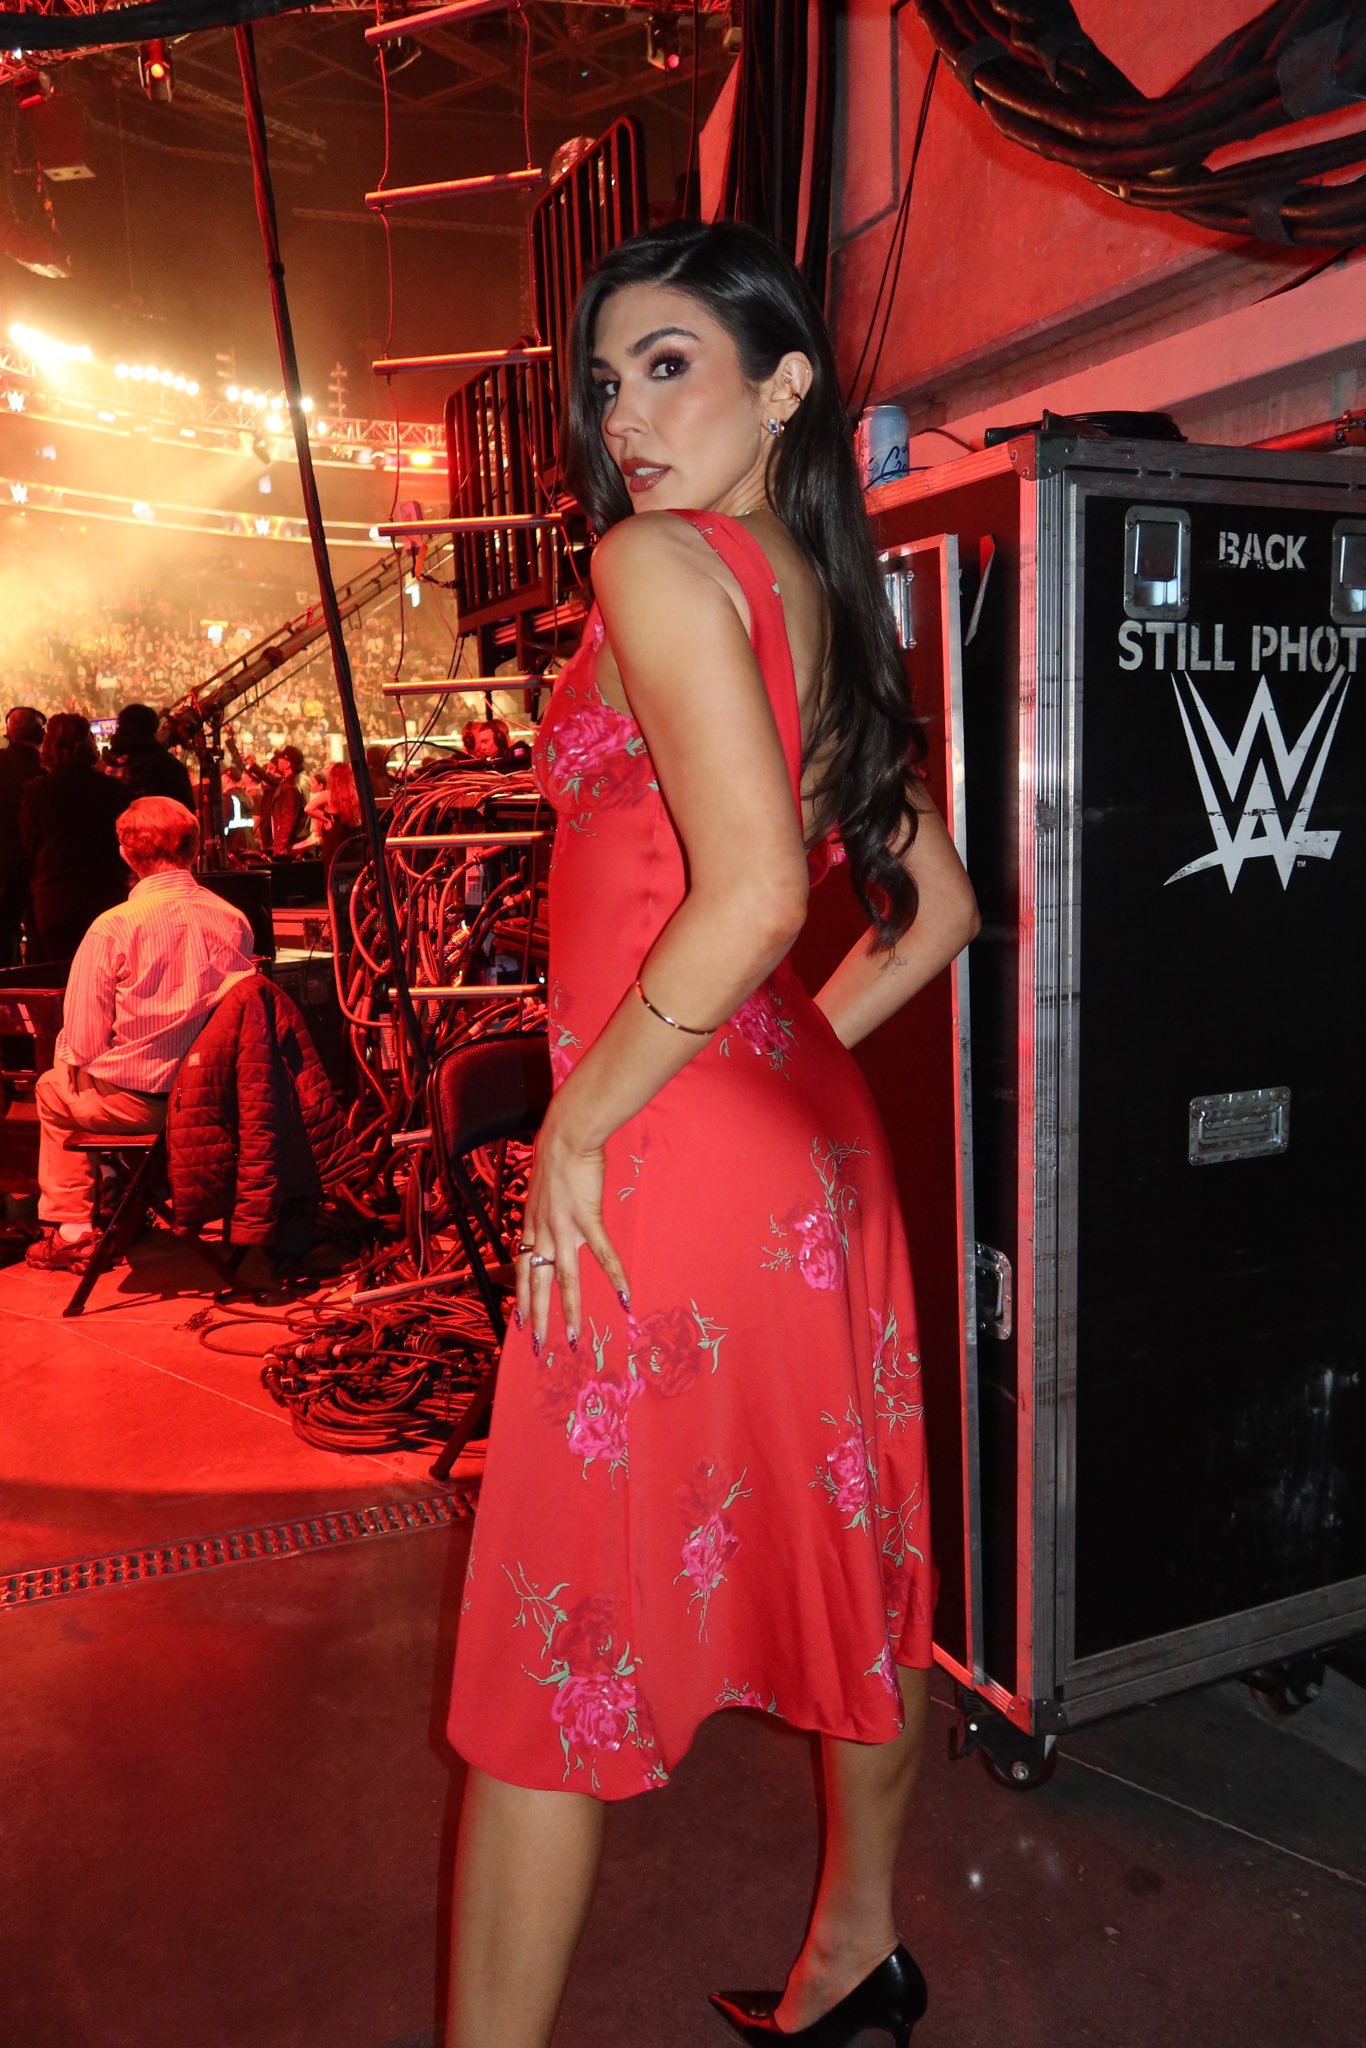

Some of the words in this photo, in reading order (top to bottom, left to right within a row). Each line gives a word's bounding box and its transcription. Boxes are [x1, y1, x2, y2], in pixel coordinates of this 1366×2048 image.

[1219, 531, 1307, 571] BACK
[1118, 620, 1235, 671] STILL
[1251, 625, 1366, 673] PHOT
